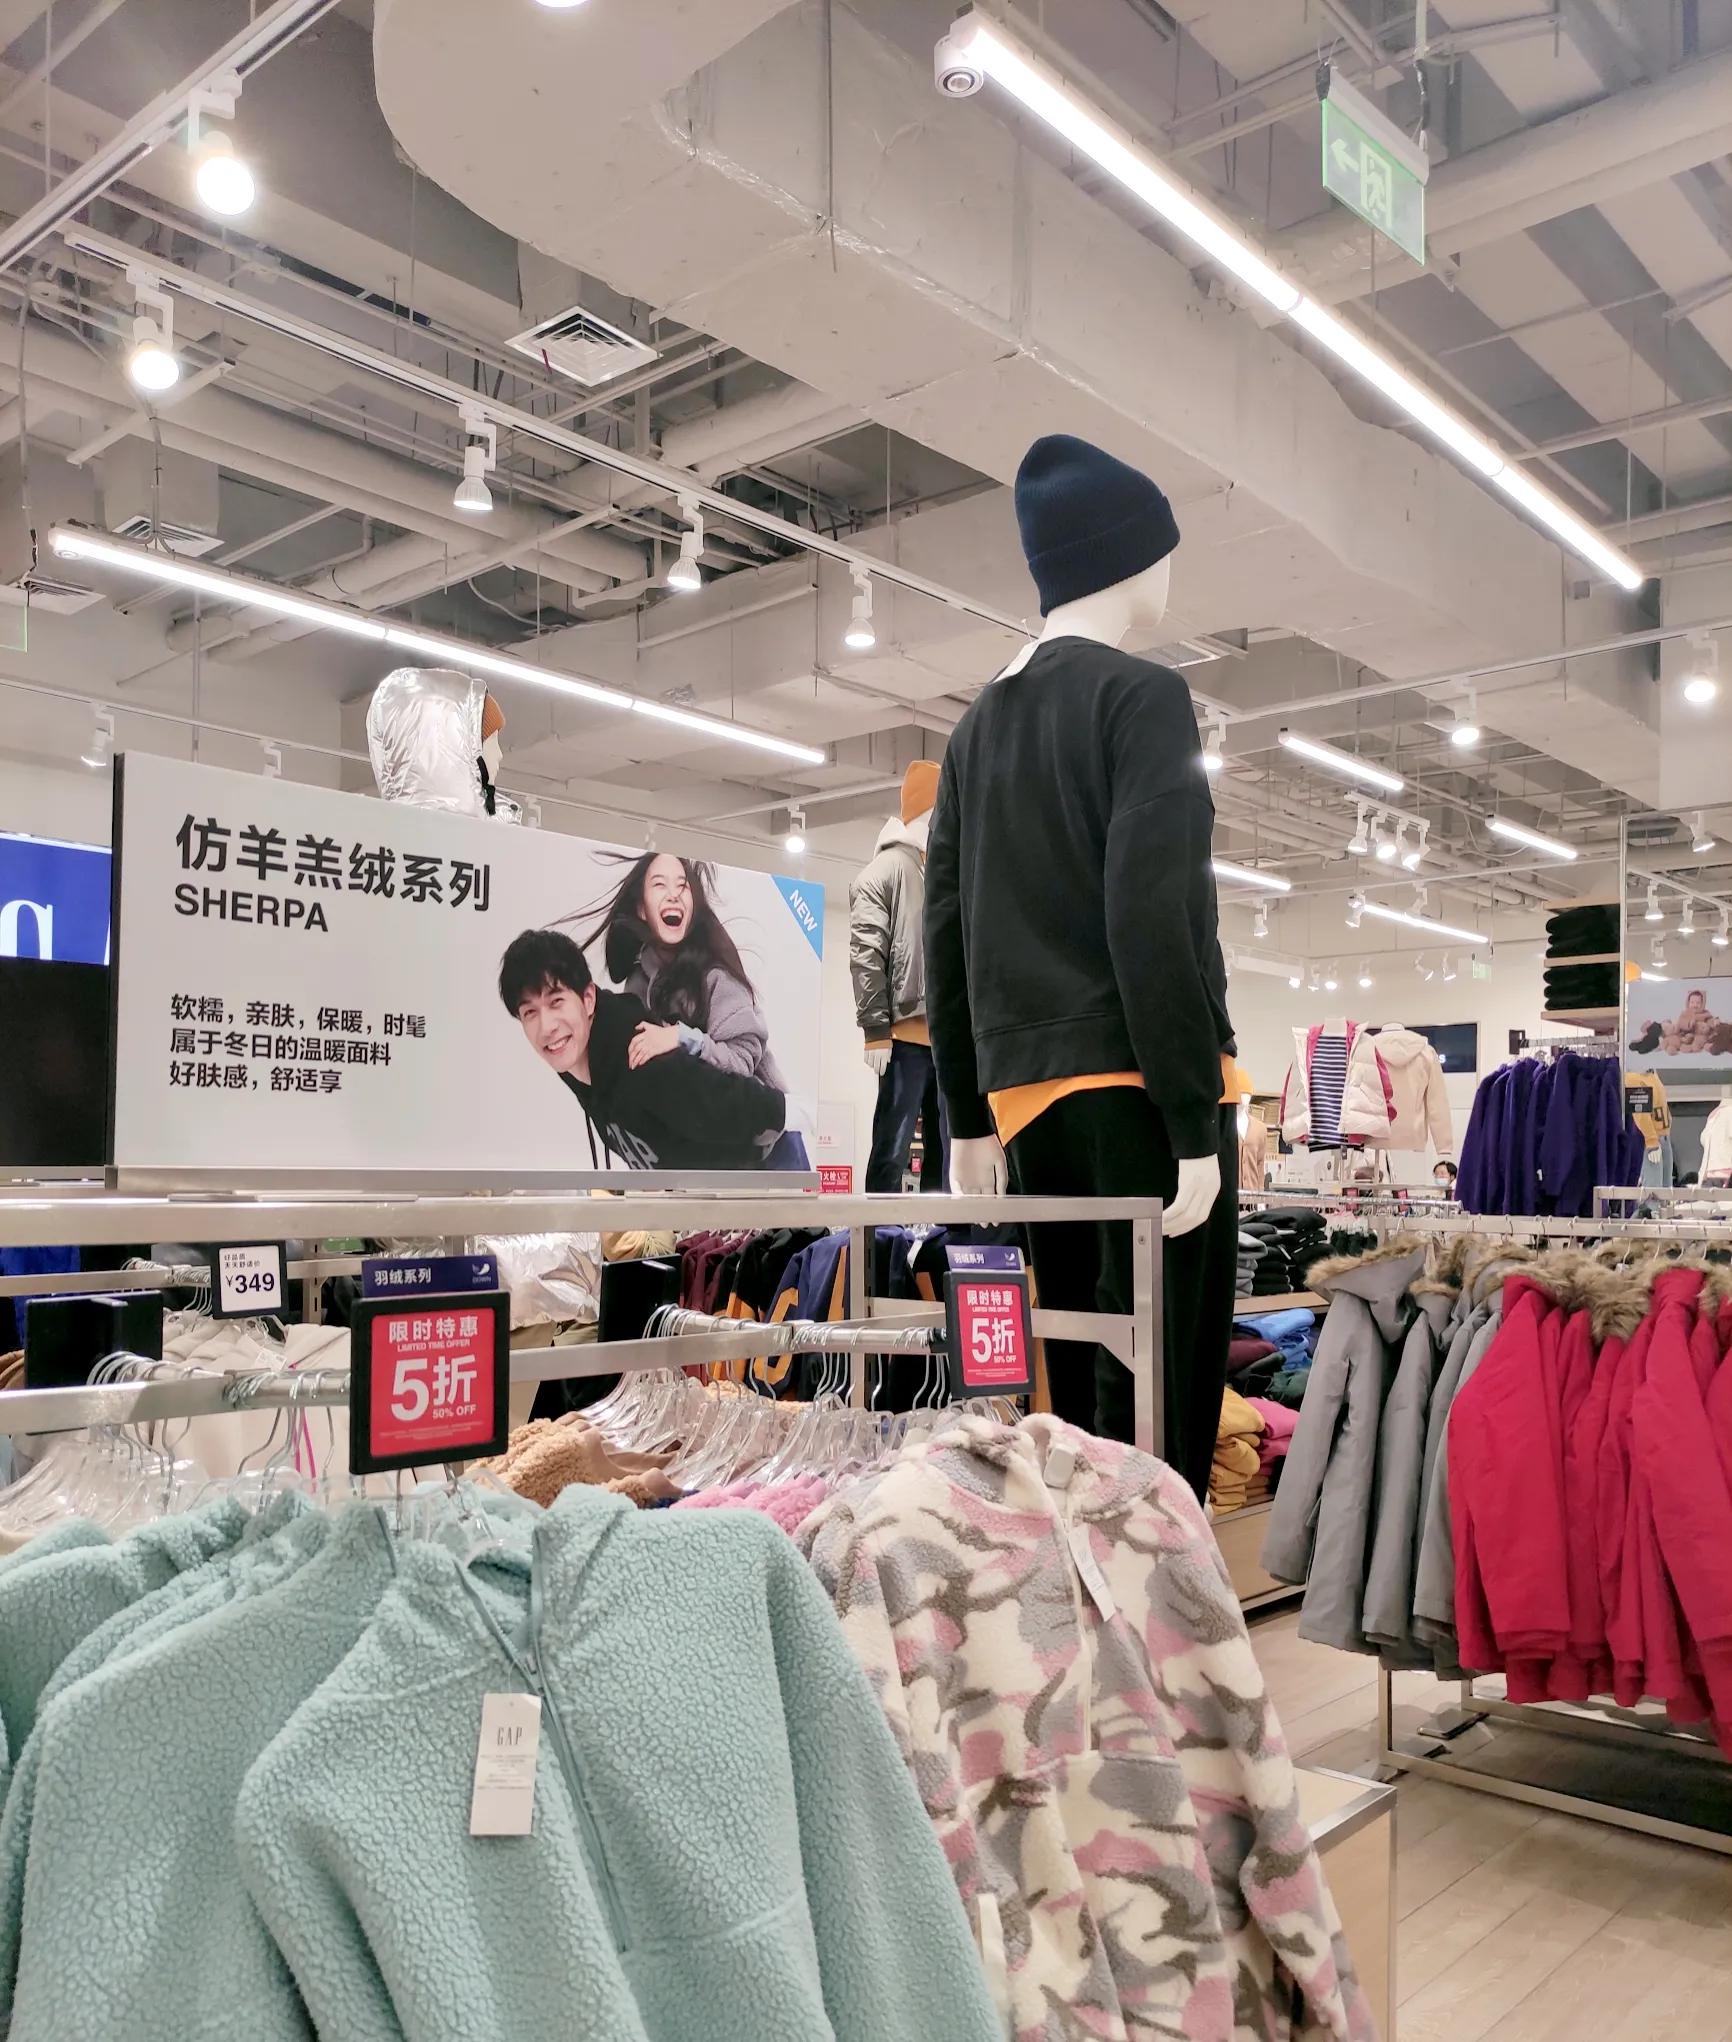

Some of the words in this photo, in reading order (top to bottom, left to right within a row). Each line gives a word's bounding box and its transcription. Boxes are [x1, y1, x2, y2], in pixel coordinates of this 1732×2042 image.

[175, 814, 491, 912] 仿羊羔绒系列
[174, 883, 329, 932] SHERPA
[789, 889, 818, 932] NEW
[169, 1028, 392, 1066] 属于冬日的温暖面料
[169, 1060, 343, 1094] 好肤感，舒适享
[374, 1268, 432, 1287] 羽绒系列
[966, 1289, 1014, 1306] 限时特惠
[388, 1315, 479, 1344] 限时特惠
[397, 1341, 427, 1353] LIMITED
[428, 1340, 446, 1350] TIME
[446, 1338, 471, 1349] OFFER
[971, 1317, 1016, 1364] 5折
[390, 1354, 478, 1422] 5折
[432, 1407, 455, 1420] 50%
[456, 1404, 477, 1416] OFF
[497, 1727, 523, 1746] GAP
